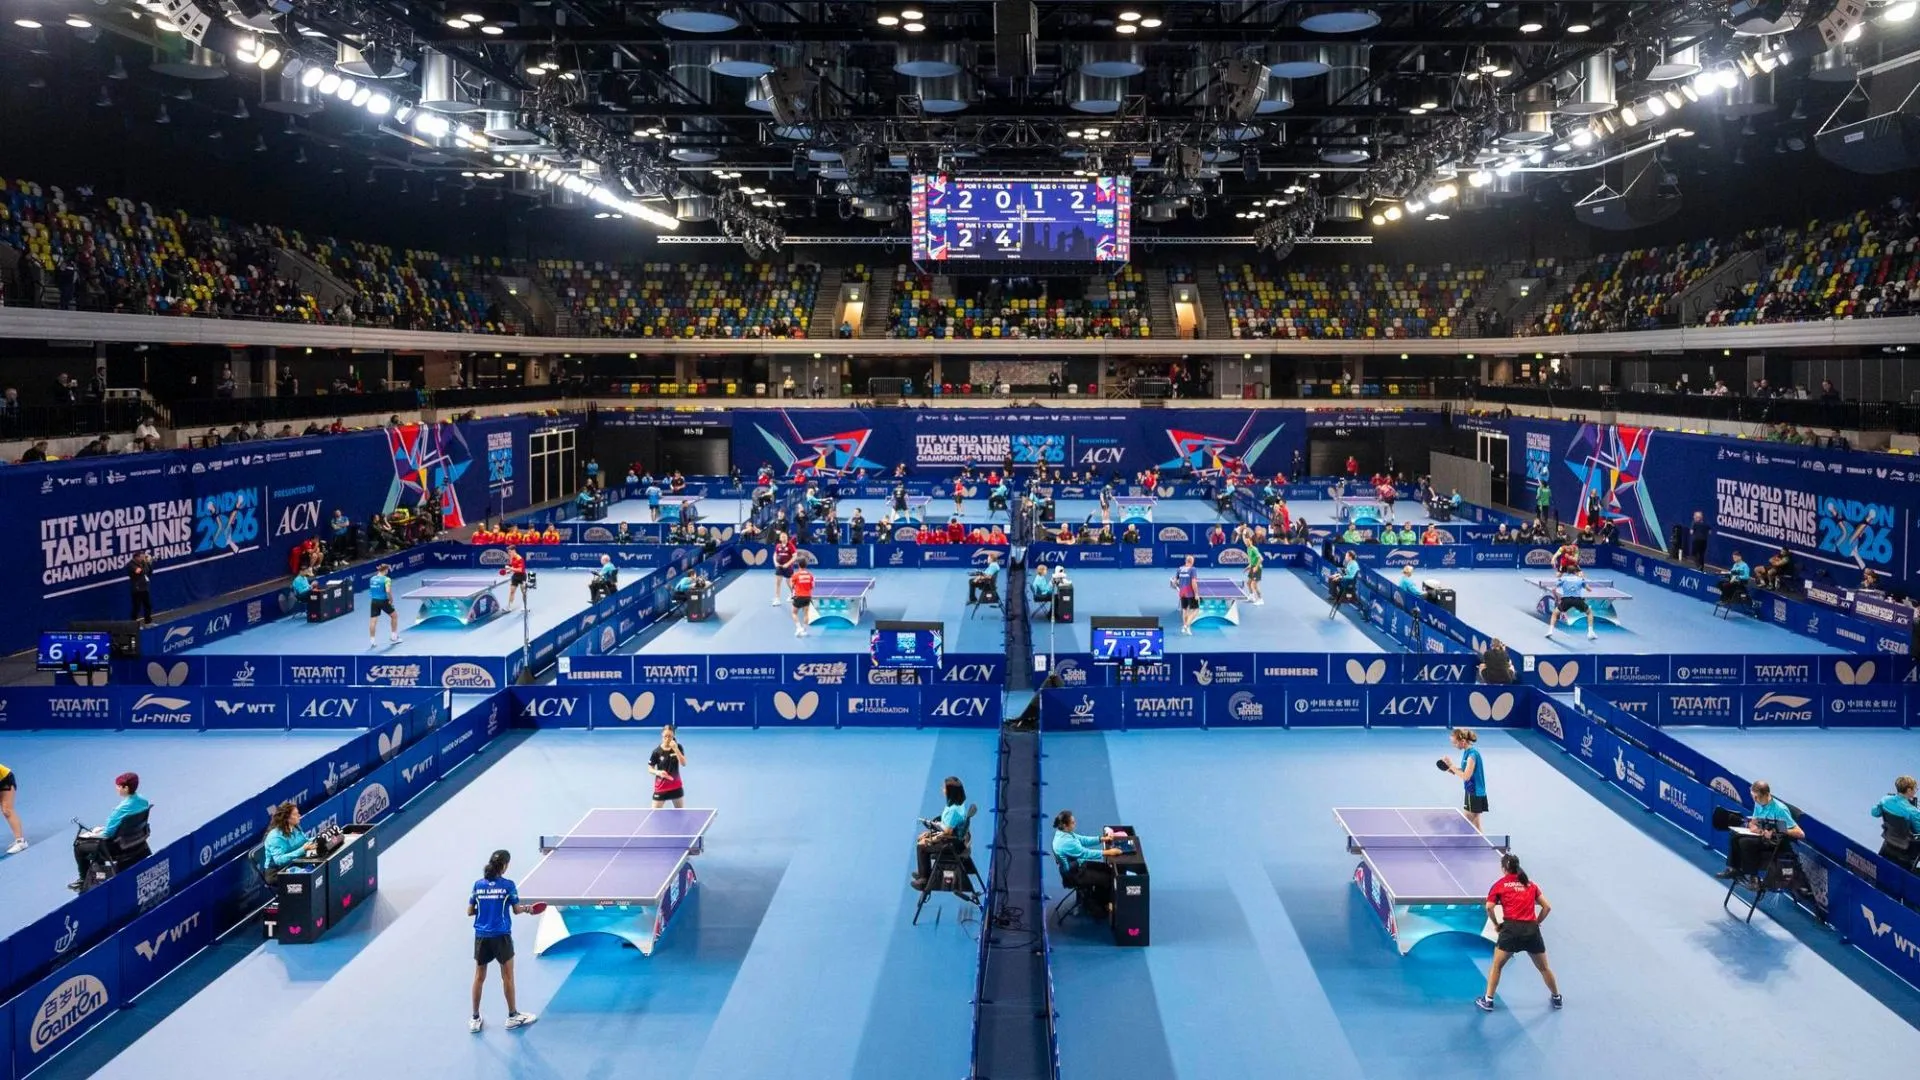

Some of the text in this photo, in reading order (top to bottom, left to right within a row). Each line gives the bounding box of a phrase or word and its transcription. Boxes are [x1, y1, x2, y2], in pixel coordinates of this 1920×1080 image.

[959, 190, 1011, 209] 2 0
[1034, 190, 1085, 209] 1 2
[959, 229, 1011, 247] 2 4
[916, 434, 1010, 444] ITTF WORLD TEAM
[916, 443, 1010, 455] TABLE TENNIS
[1080, 448, 1124, 463] ACN
[273, 487, 303, 499] PRESENTED
[836, 487, 857, 496] ACN
[1185, 487, 1207, 496] ACN
[1716, 478, 1816, 511] ITTF WORLD TEAM
[196, 487, 258, 518] LONDON
[40, 498, 193, 541] ITTF WORLD TEAM
[275, 499, 323, 537] ACN
[1716, 494, 1817, 535] TABLE TENNIS
[1818, 495, 1895, 528] LONDON
[1716, 514, 1817, 548] CHAMPIONSHIPS FINALS
[42, 516, 192, 569] TABLE TENNIS
[1818, 517, 1894, 564] 2026
[153, 541, 192, 560] FINALS
[1035, 550, 1067, 563] ACN
[1681, 575, 1700, 590] ACN
[205, 612, 233, 635] ACN
[49, 643, 64, 660] 6
[85, 643, 98, 660] 2
[163, 636, 195, 654] LI-NING
[1103, 639, 1117, 656] 7
[1138, 639, 1152, 656] 2
[290, 666, 346, 678] TATA木门
[567, 671, 622, 680] LIEBHERR
[643, 665, 698, 677] TATA木门
[942, 664, 996, 682] ACN
[1264, 667, 1319, 677] LIEBHERR
[1413, 664, 1467, 681] ACN
[1620, 666, 1640, 674] ITTF
[1754, 665, 1808, 677] TATA木门
[49, 698, 109, 711] TATA木门
[247, 704, 276, 713] WTT
[300, 698, 358, 717] ACN
[520, 697, 578, 717] ACN
[716, 701, 746, 711] WTT
[864, 698, 887, 706] ITTF
[931, 697, 990, 716] ACN
[1135, 697, 1193, 711] TATA木门
[1310, 699, 1360, 707] 中国农业银行
[1379, 696, 1438, 715] ACN
[1619, 702, 1648, 712] WTT
[1670, 696, 1730, 710] TATA木门
[1847, 699, 1897, 708] 中国农业银行
[131, 713, 192, 723] LI-NING
[1753, 711, 1812, 721] LI-NING
[416, 755, 433, 775] WTT
[1671, 786, 1687, 804] ITTF
[1671, 799, 1704, 823] FOUNDATION
[169, 911, 200, 942] WTT
[264, 921, 277, 937] T
[45, 979, 87, 1019] 百岁山
